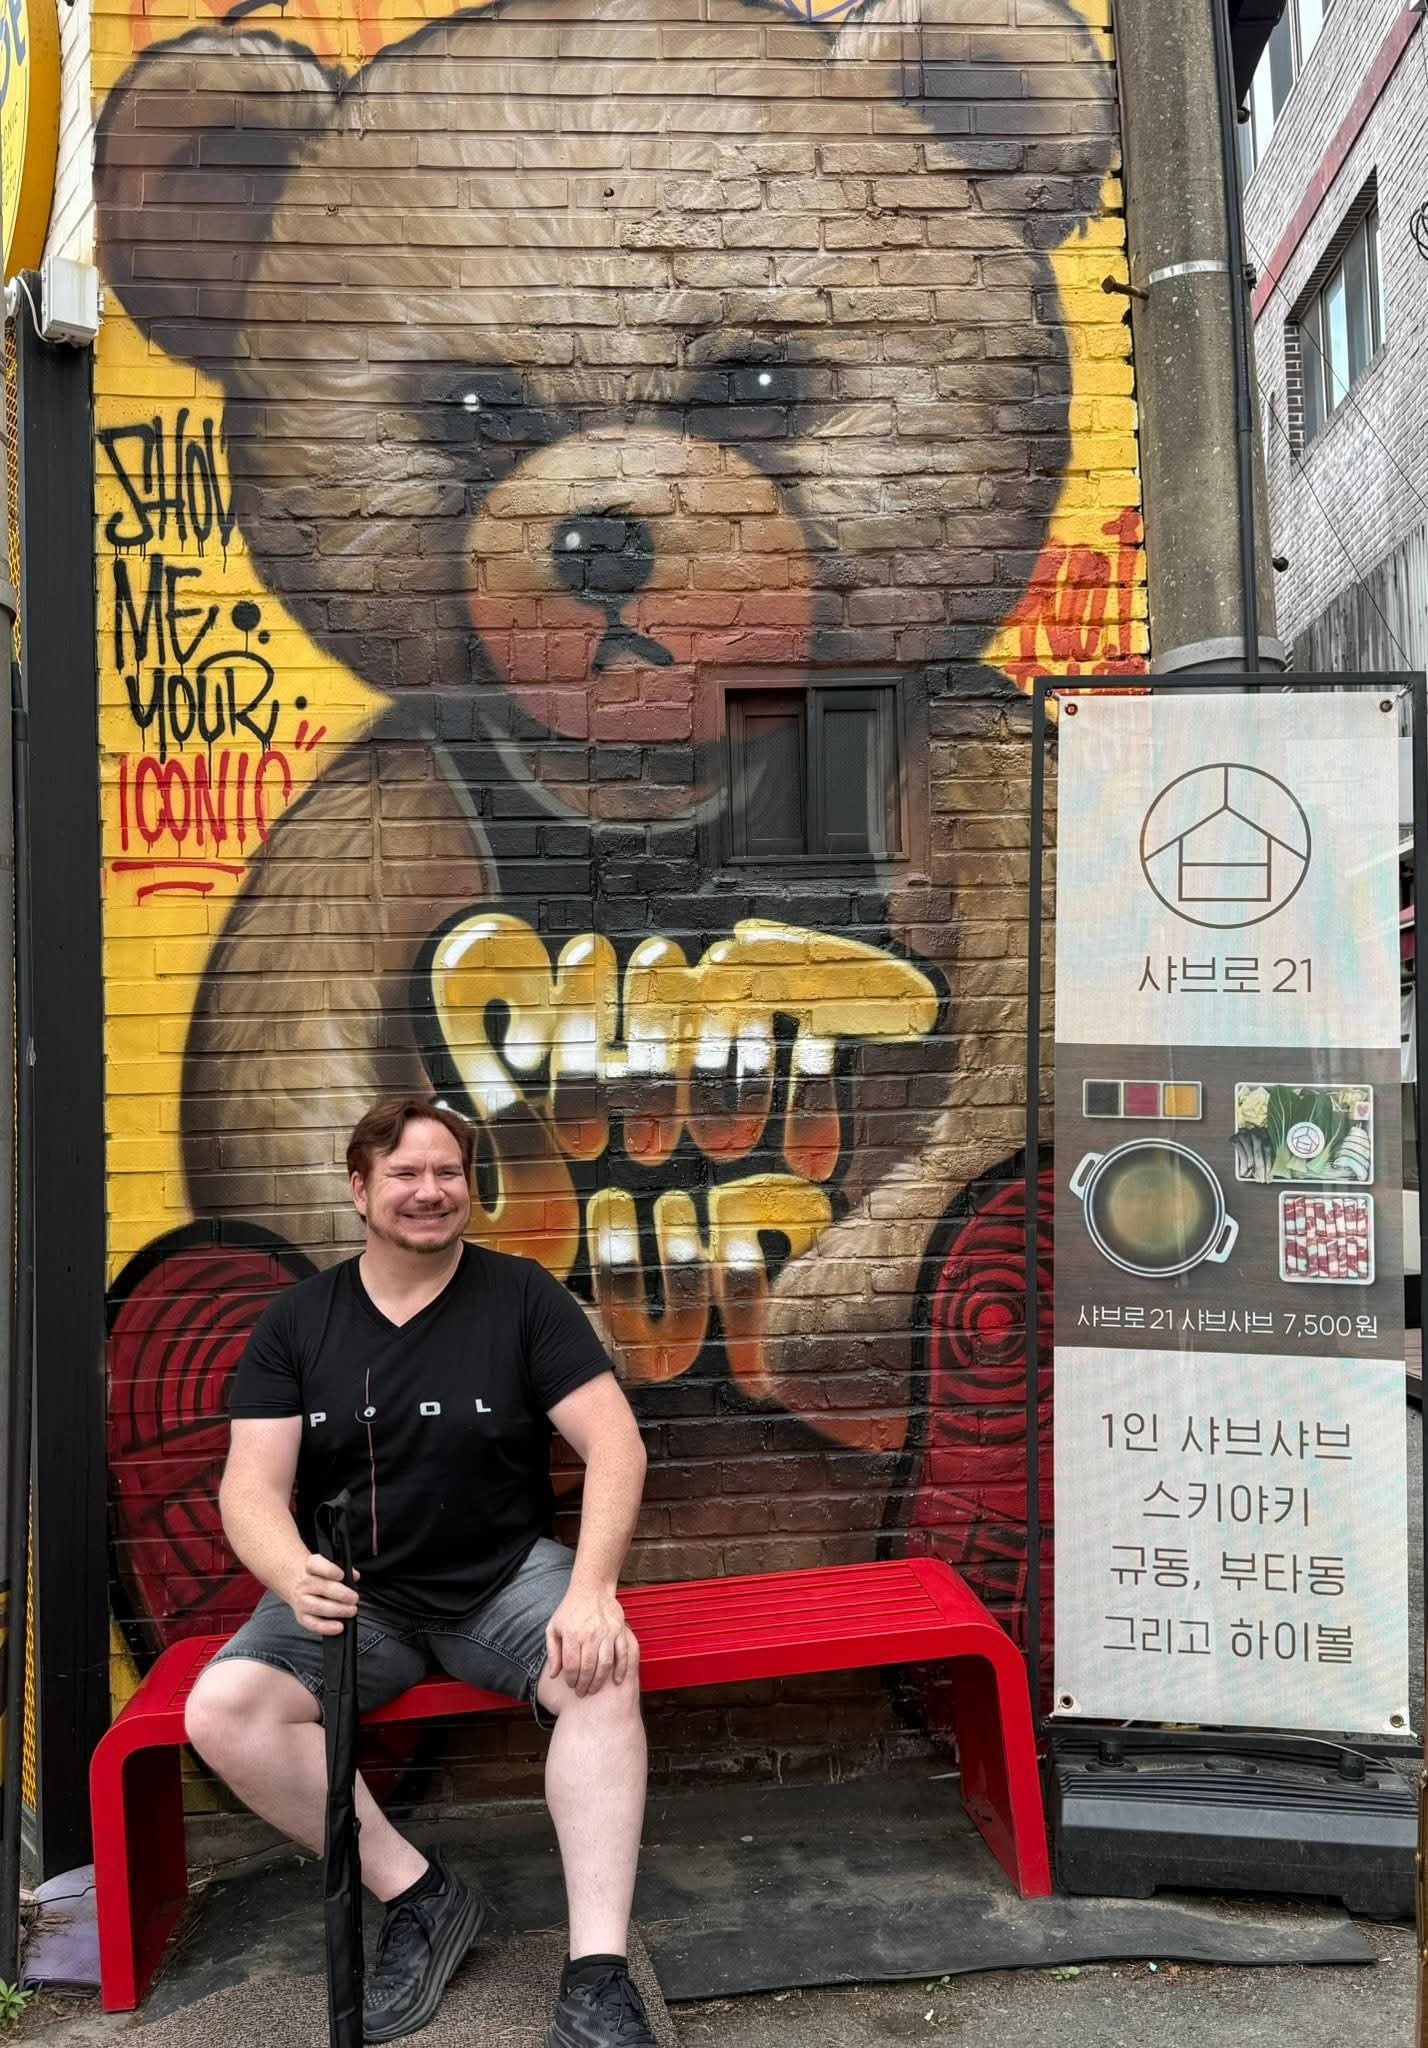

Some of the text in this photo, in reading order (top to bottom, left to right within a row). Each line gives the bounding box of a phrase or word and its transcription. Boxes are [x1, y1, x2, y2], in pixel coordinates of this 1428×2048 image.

[113, 553, 219, 674] ME
[126, 650, 280, 763] YOUR
[1138, 955, 1313, 993] 샤브로 21
[586, 1172, 834, 1400] UP
[1181, 1308, 1275, 1335] 샤브샤브
[1283, 1312, 1378, 1340] 7,500원
[1101, 1412, 1353, 1460] 1인 샤브샤브
[1142, 1480, 1309, 1527] 스키야키
[1110, 1544, 1346, 1597] 규동, 부타동
[1103, 1615, 1354, 1665] 그리고 하이볼
